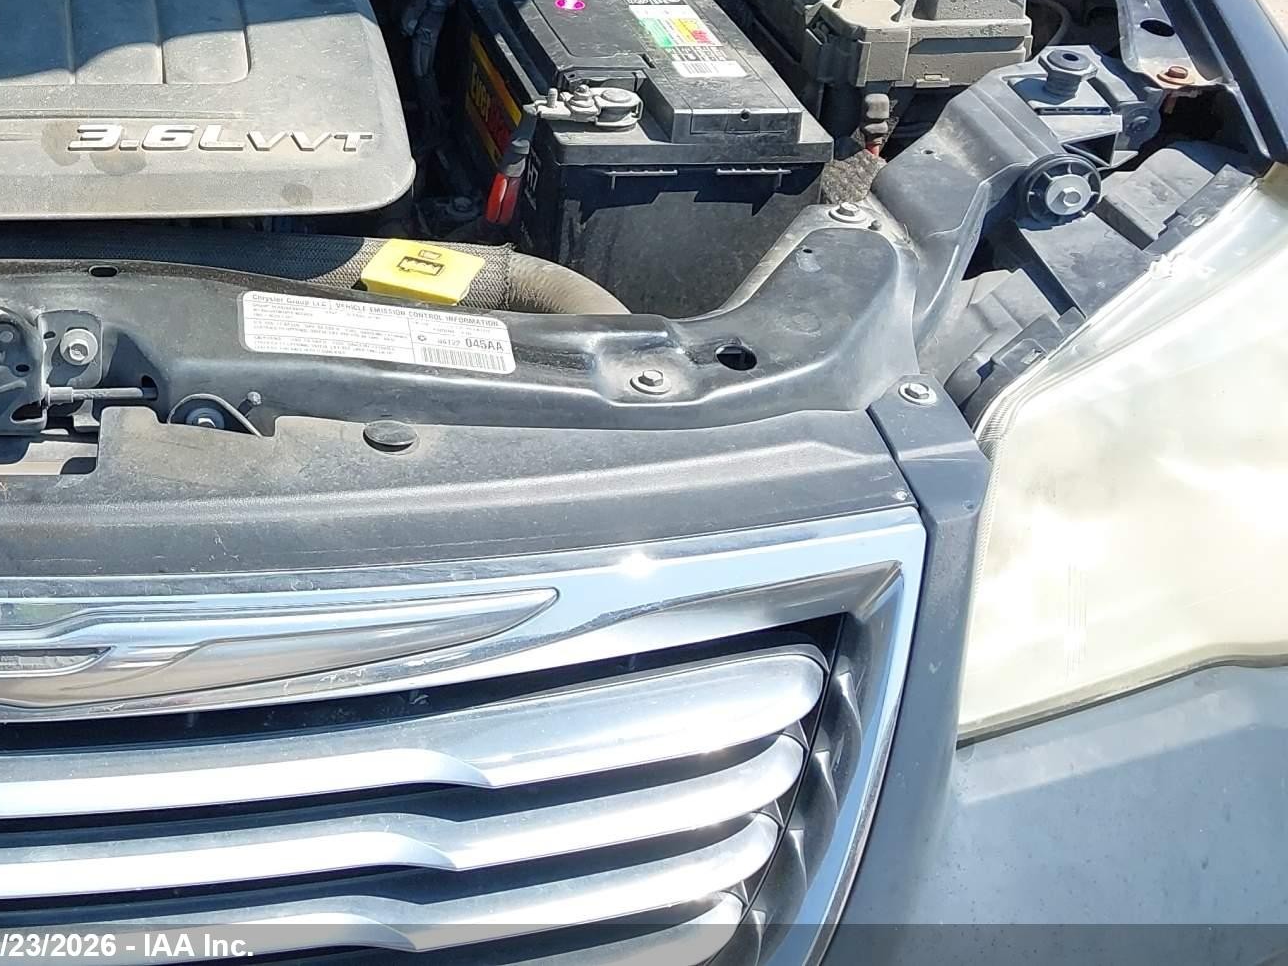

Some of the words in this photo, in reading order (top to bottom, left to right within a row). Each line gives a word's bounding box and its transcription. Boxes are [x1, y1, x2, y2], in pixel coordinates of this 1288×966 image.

[252, 294, 284, 303] Chrysler
[287, 297, 310, 306] Group
[336, 303, 366, 312] VEHICLE
[369, 306, 406, 316] EMISSION
[408, 311, 443, 321] CONTROL
[445, 315, 500, 327] INFORMATION
[465, 337, 504, 352] 045AA
